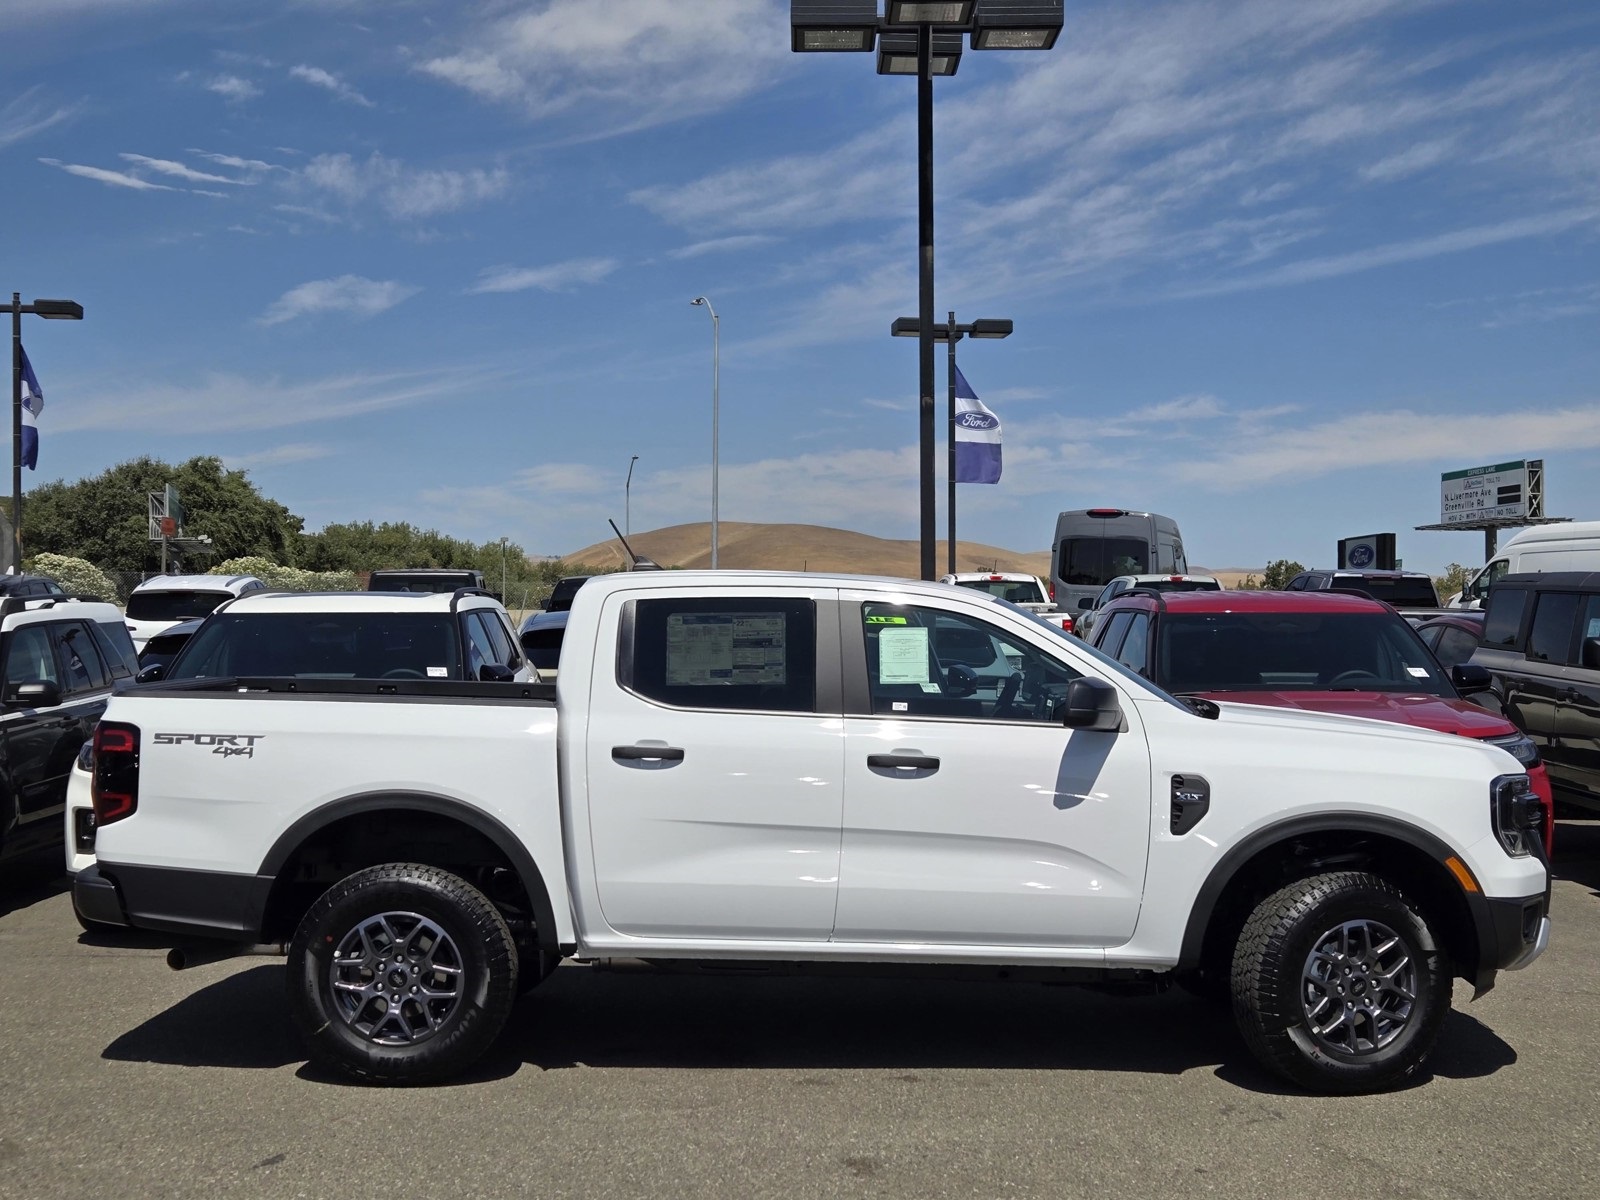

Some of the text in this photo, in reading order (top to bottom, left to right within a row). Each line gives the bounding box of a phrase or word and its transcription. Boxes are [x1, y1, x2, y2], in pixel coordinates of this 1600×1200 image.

[962, 413, 991, 428] Ford
[1467, 467, 1484, 476] EXPRESS
[1444, 488, 1491, 501] N Livermore Ave
[1444, 498, 1484, 511] Greenville Rd
[1466, 511, 1476, 519] WITH
[1505, 507, 1517, 515] TOLL
[1353, 548, 1370, 564] Ford
[152, 733, 266, 746] SPORT
[1175, 791, 1204, 801] XLT
